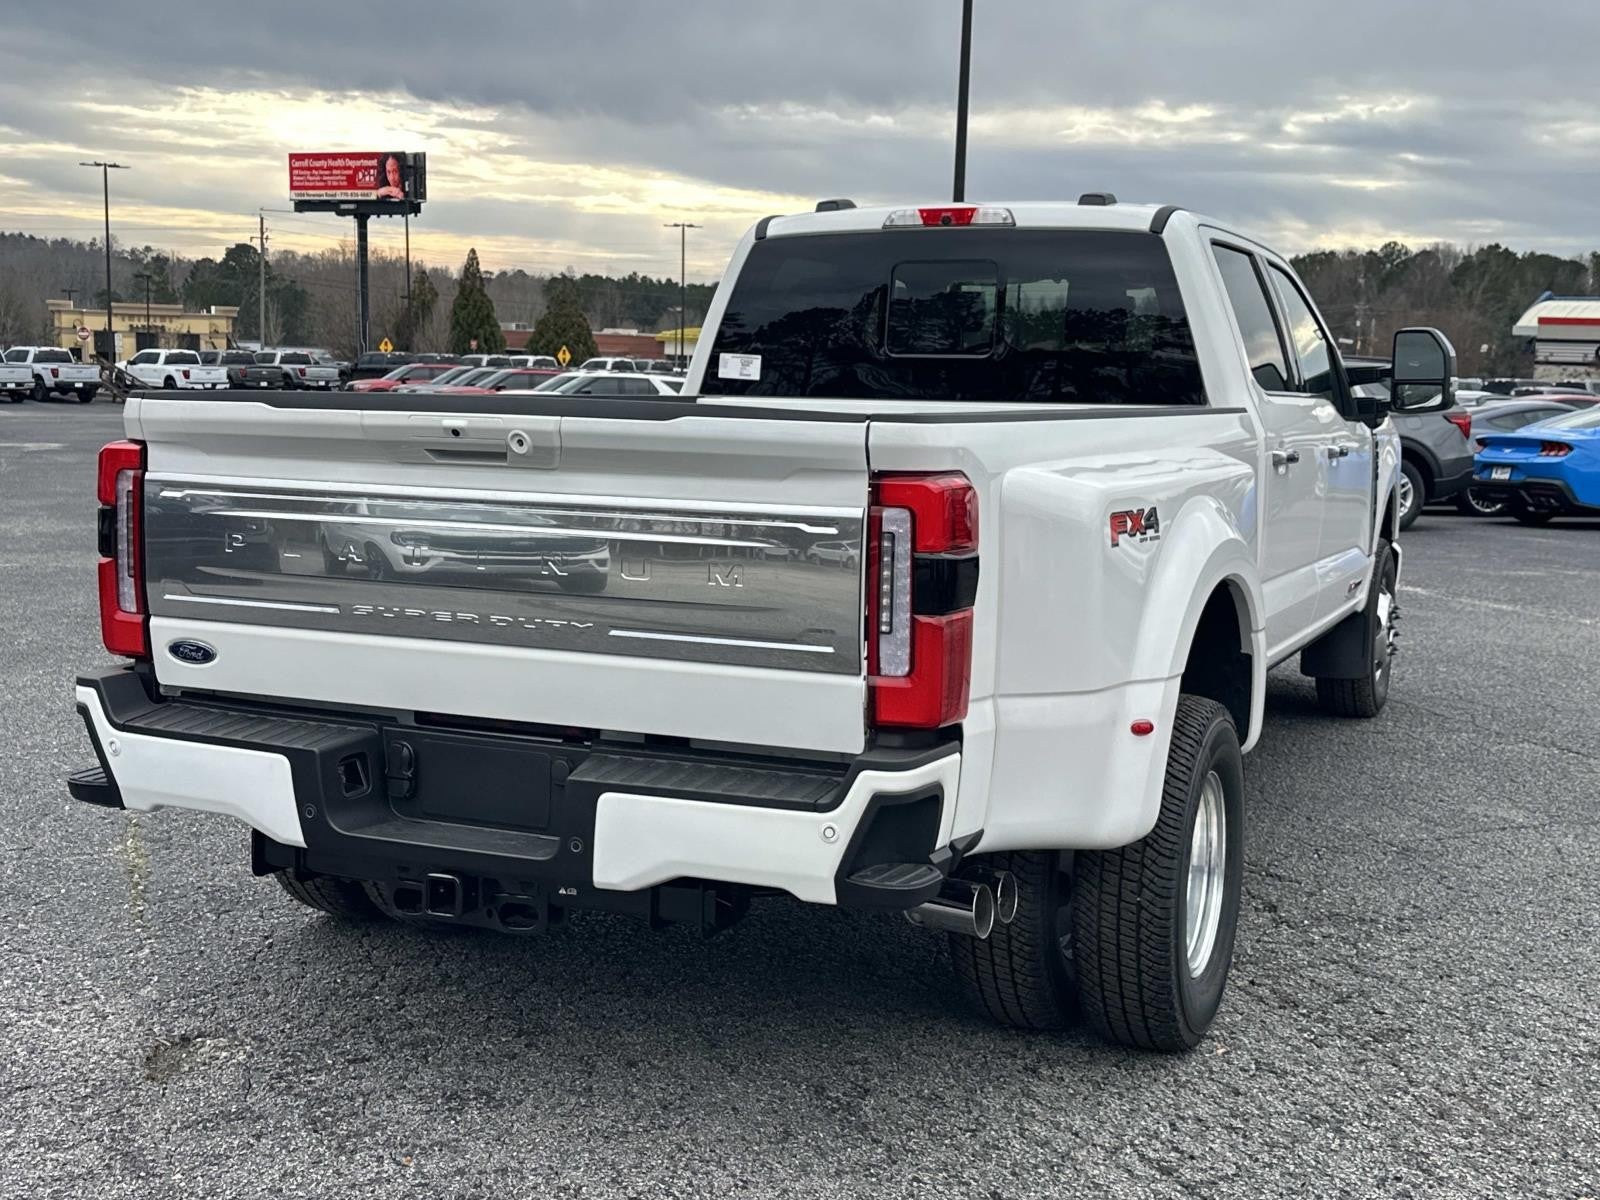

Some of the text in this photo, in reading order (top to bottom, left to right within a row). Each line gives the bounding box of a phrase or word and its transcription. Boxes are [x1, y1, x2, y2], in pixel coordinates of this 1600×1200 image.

[291, 158, 378, 168] Carroll County Health Department
[1110, 506, 1160, 548] FX4
[224, 531, 745, 588] PLATINUM
[352, 604, 595, 629] SUPER DUTY
